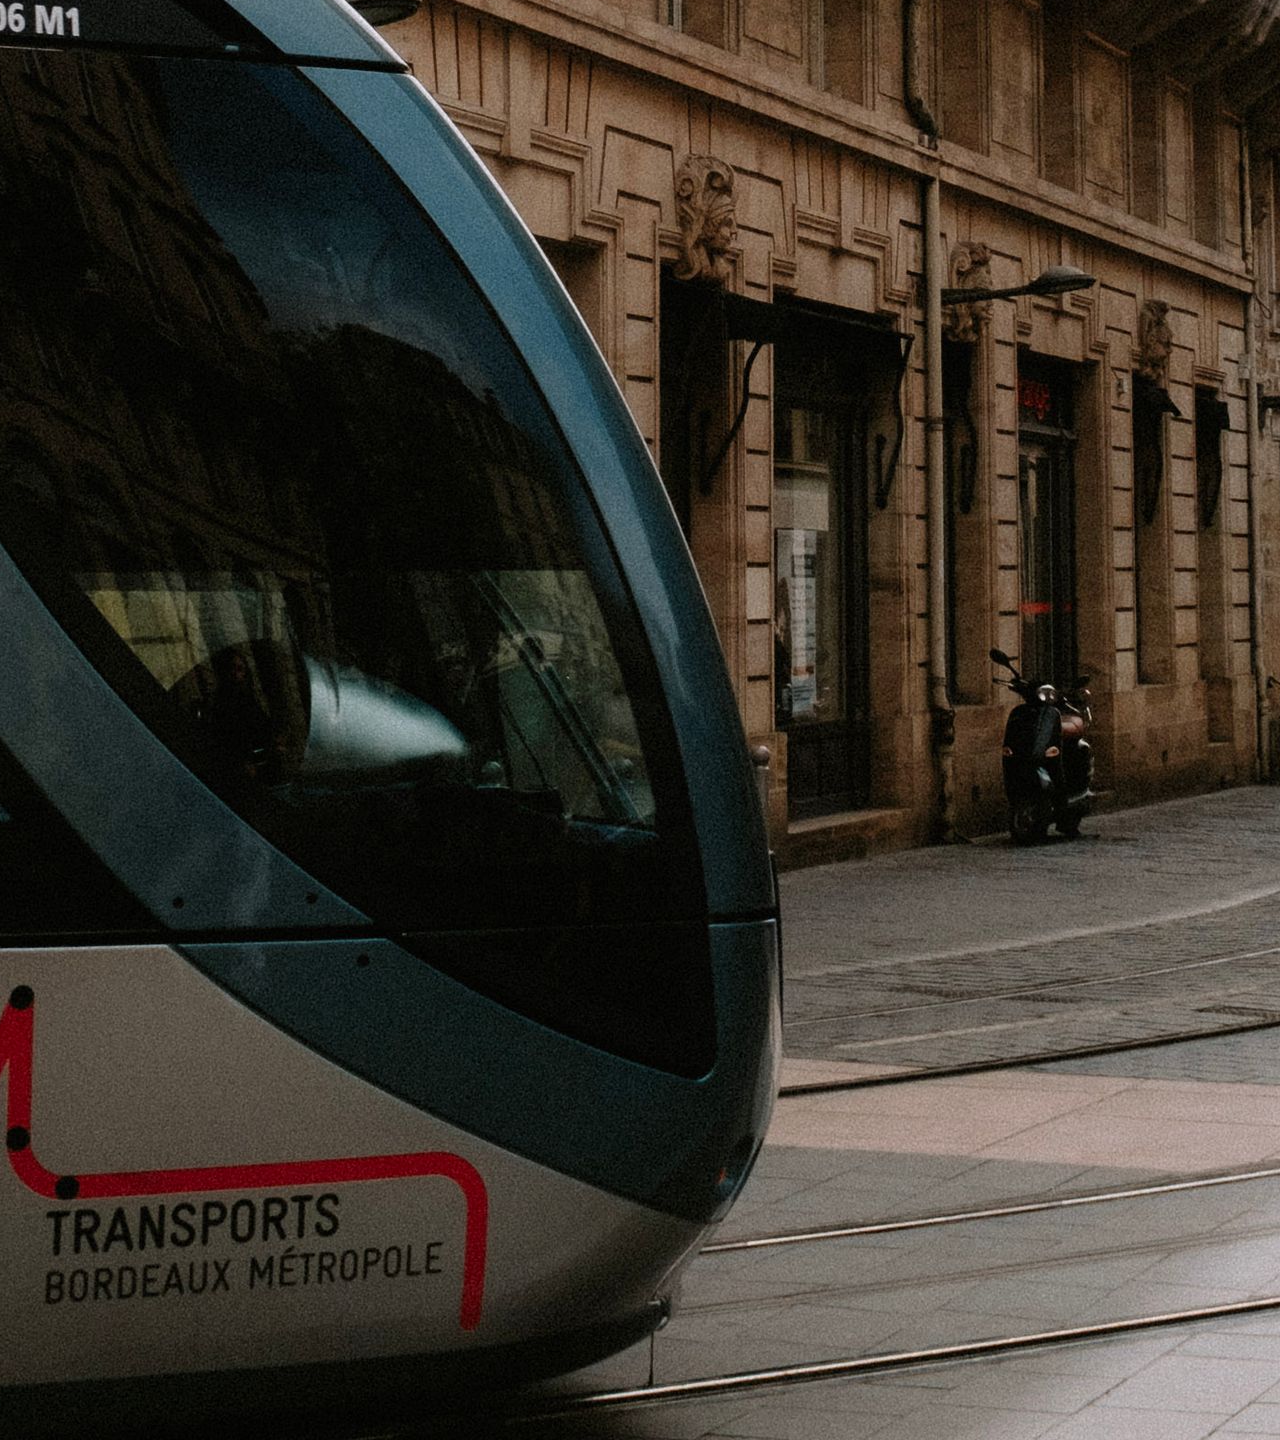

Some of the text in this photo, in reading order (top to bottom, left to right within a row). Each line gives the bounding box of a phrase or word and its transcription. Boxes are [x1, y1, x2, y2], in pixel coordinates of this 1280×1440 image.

[34, 4, 80, 37] M1
[46, 1193, 341, 1256] TRANSPORTS
[44, 1242, 444, 1305] BORDEAUX MÉTROPOLE
